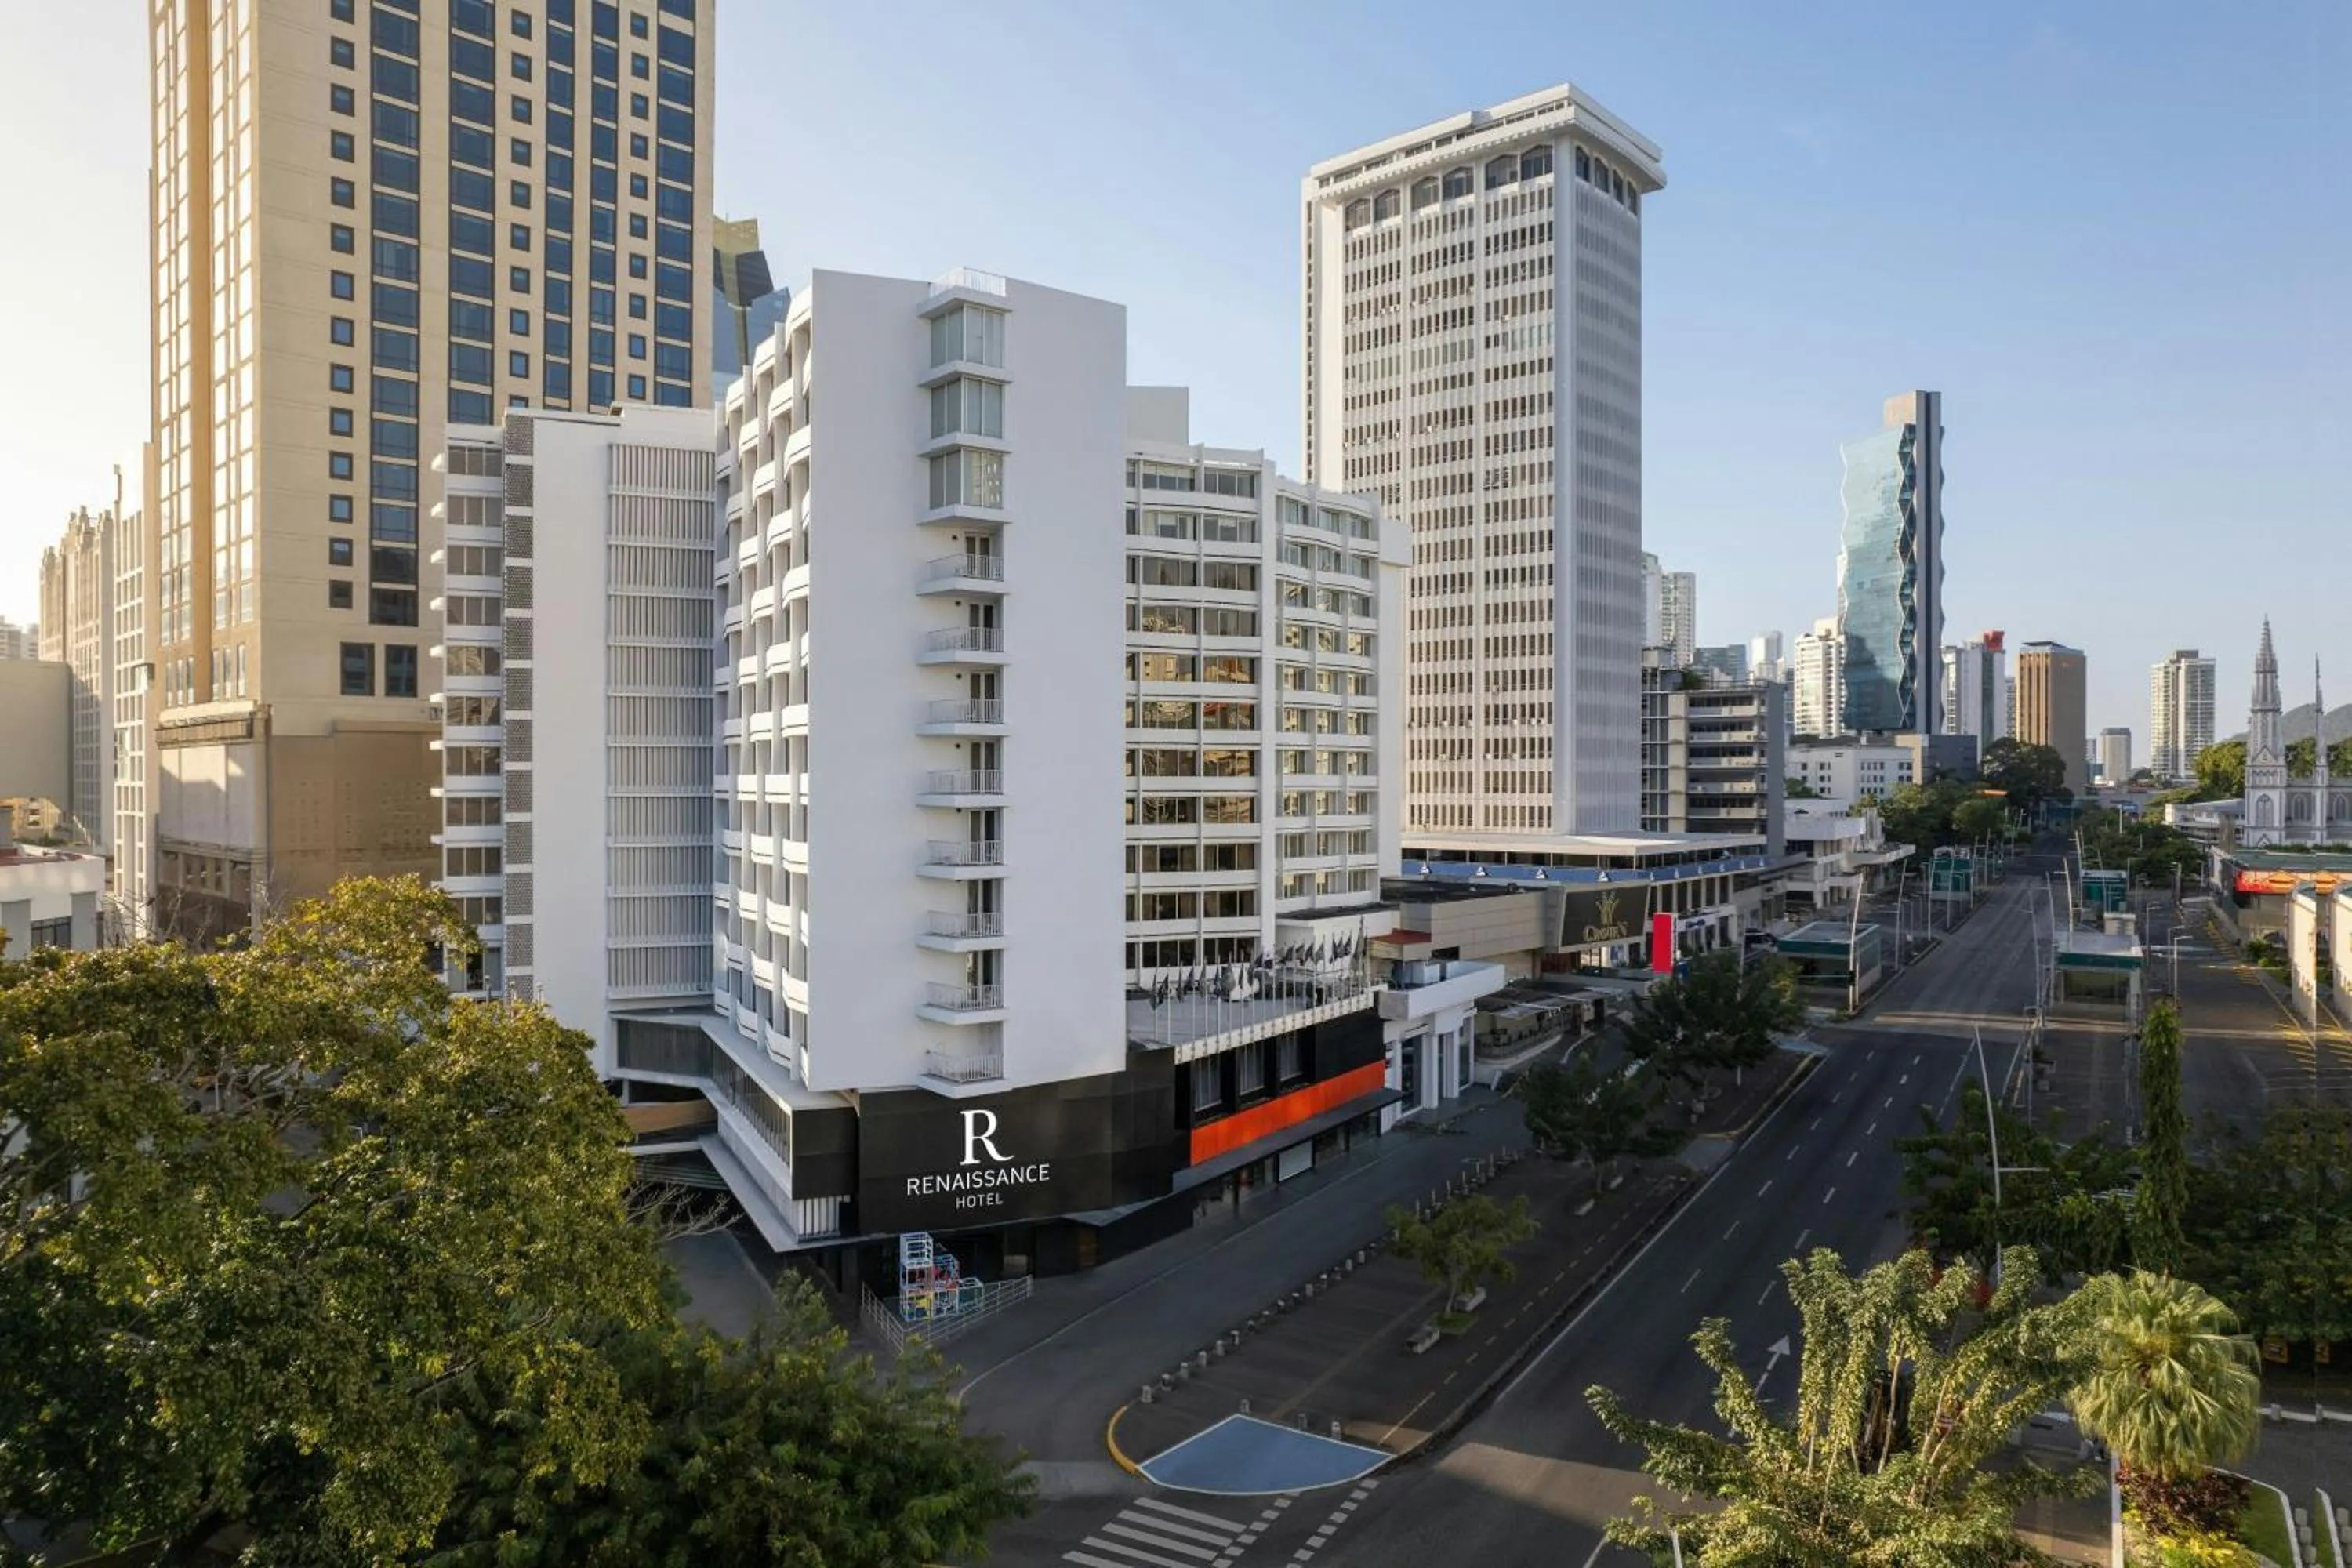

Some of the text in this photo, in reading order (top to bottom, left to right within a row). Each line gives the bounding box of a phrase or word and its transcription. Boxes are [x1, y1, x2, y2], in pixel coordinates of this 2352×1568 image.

[960, 1109, 1014, 1166] R
[906, 1163, 1051, 1196] RENAISSANCE
[956, 1192, 1004, 1208] HOTEL
